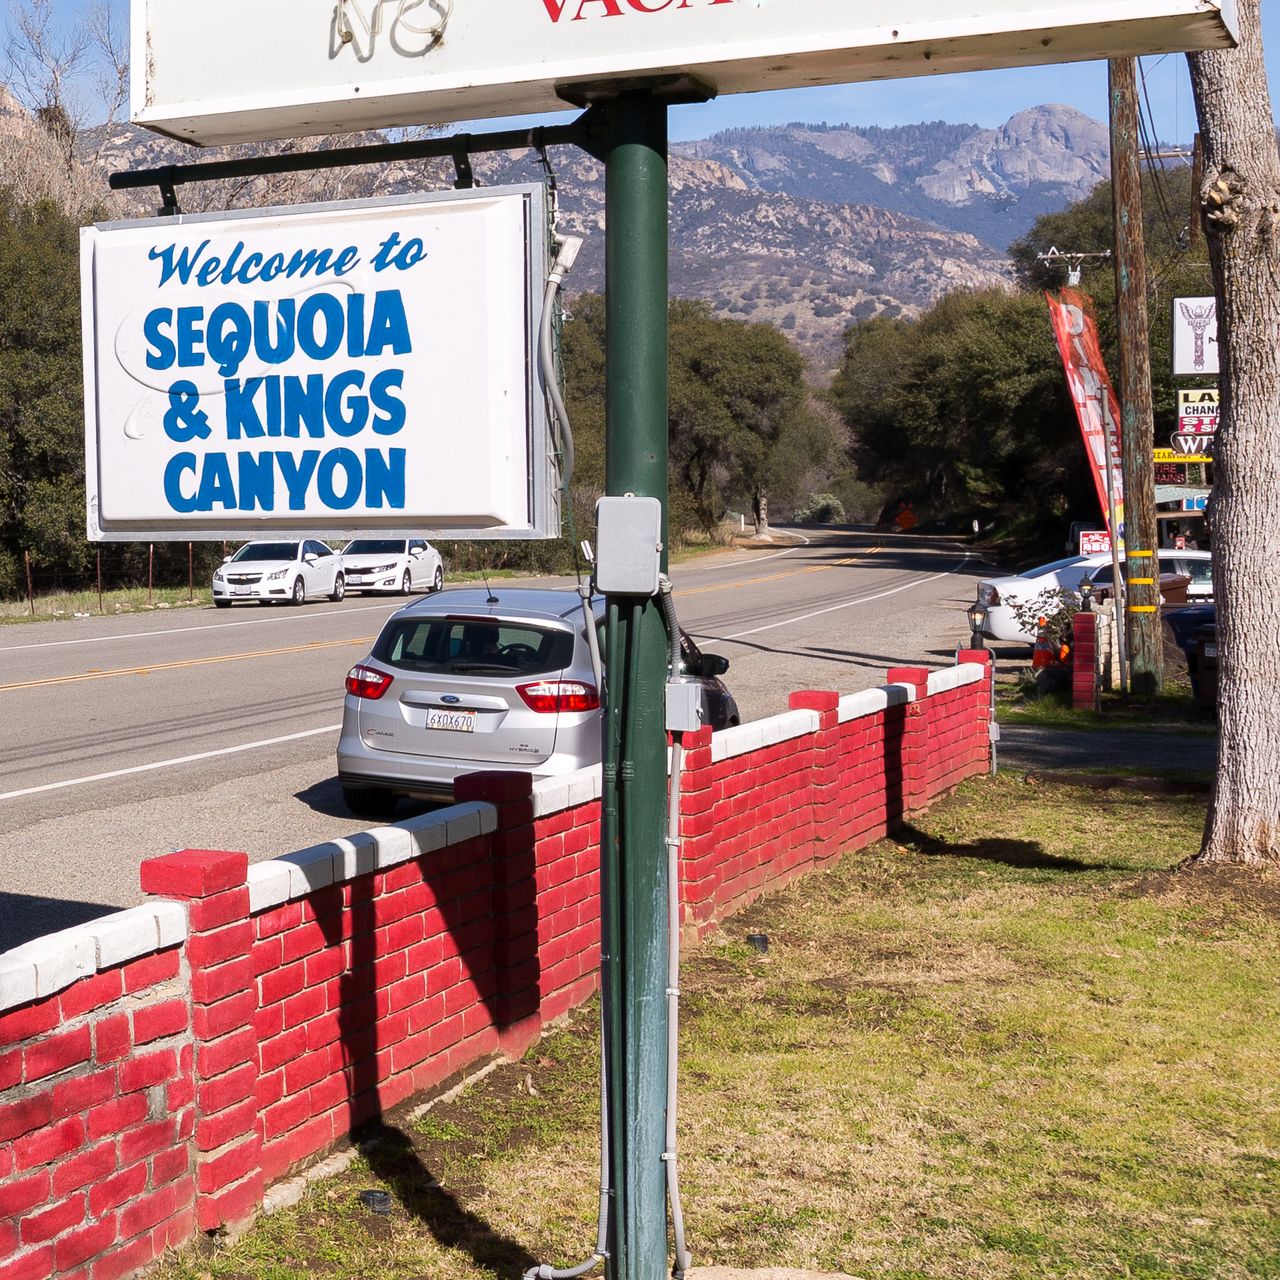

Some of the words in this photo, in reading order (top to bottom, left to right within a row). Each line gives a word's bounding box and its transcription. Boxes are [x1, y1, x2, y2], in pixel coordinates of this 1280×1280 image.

[149, 240, 361, 288] Welcome
[370, 232, 427, 273] to
[143, 290, 413, 378] SEQUOIA
[163, 380, 213, 442] &
[223, 369, 407, 440] KINGS
[1182, 392, 1219, 403] LA
[163, 448, 407, 513] CANYON
[1155, 464, 1177, 473] TIRE
[1155, 473, 1185, 484] HAINS
